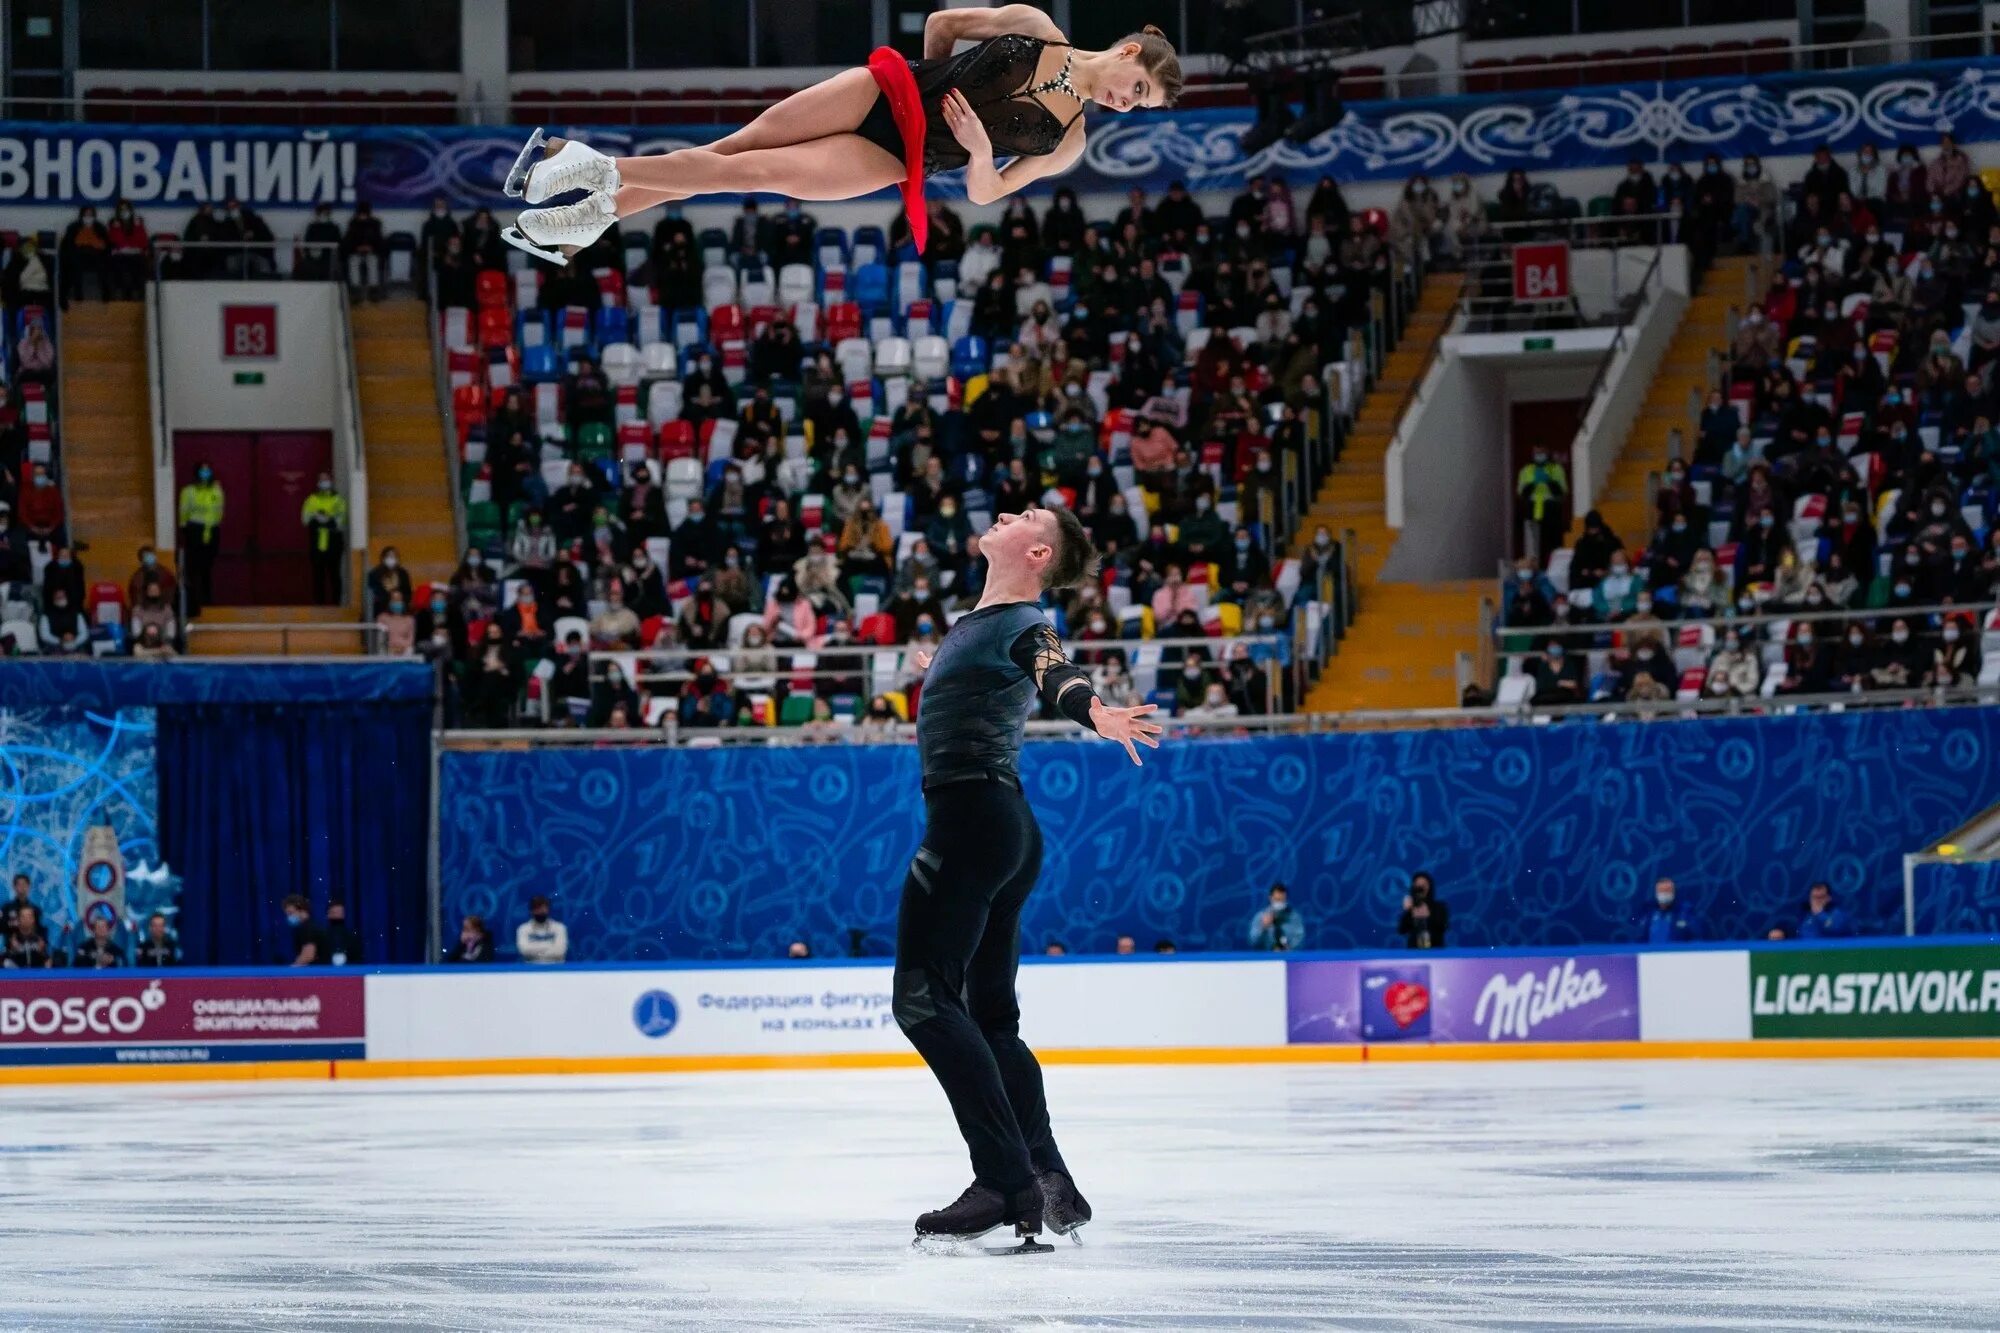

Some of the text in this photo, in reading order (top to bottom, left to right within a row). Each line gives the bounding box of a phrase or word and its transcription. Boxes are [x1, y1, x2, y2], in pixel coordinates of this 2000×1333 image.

[0, 129, 357, 202] ВНОВАНИЙ!
[193, 995, 321, 1015] ОФИЦИАЛЬНЫЙ
[1474, 958, 1608, 1041] Milka
[1753, 970, 2000, 1016] LIGASTAVOK.R
[0, 997, 146, 1035] BOSCO
[193, 1015, 320, 1032] ЭКИПИРОВЩИК
[762, 1018, 785, 1032] на
[792, 1017, 874, 1032] коньках
